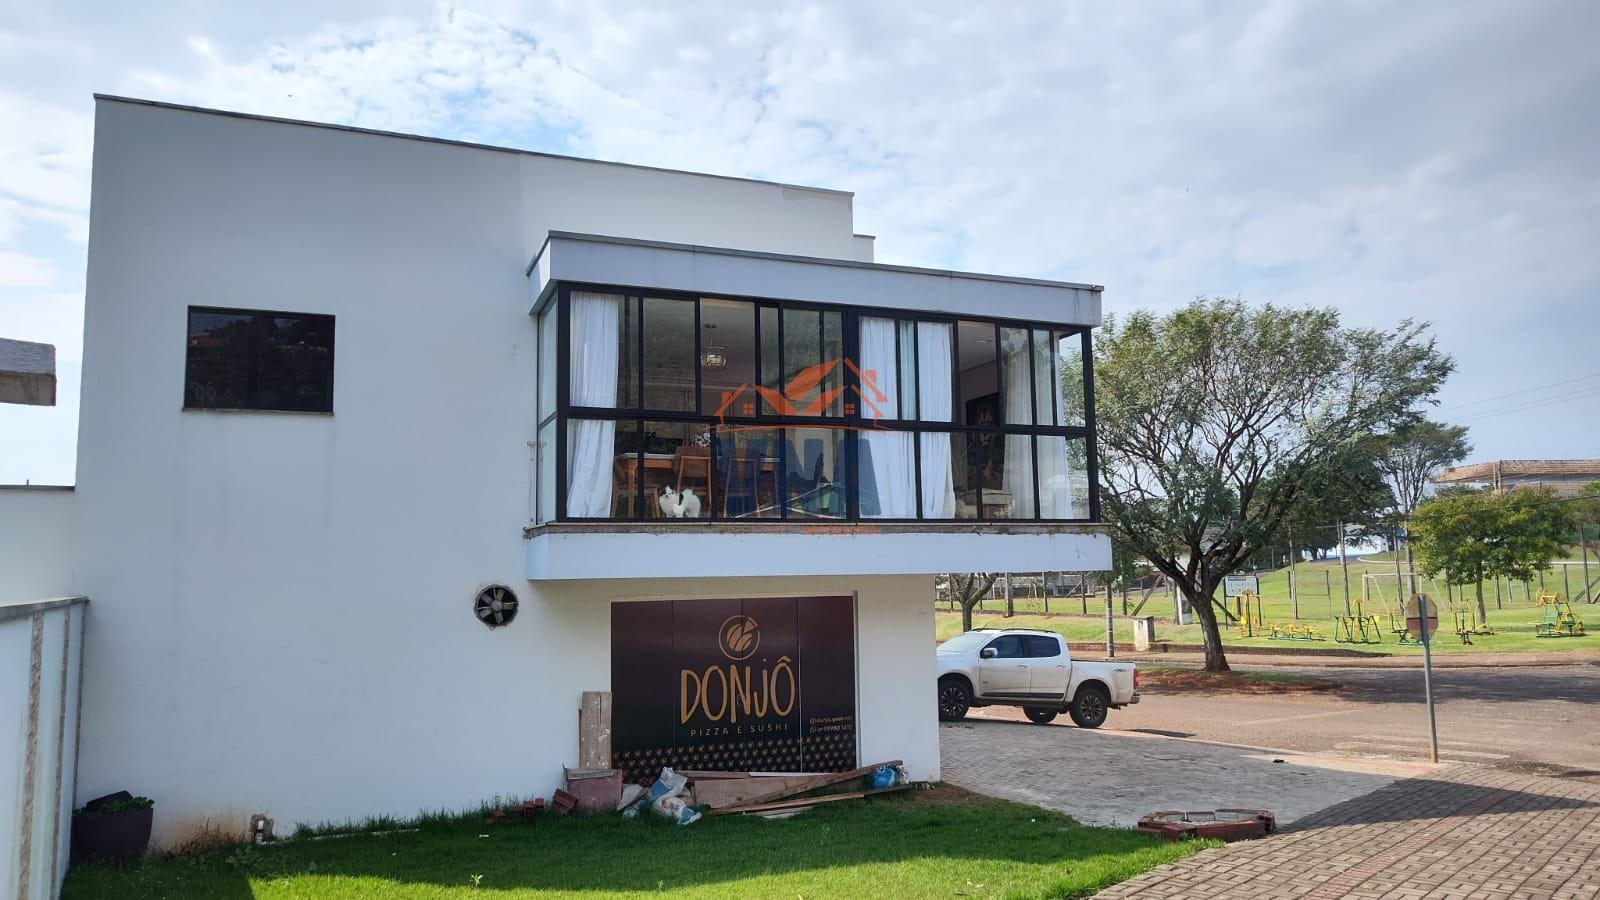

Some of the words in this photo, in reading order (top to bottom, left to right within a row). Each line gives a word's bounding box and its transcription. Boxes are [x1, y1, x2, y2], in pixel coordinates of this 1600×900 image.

[690, 727, 729, 737] PIZZA
[737, 725, 743, 734] E
[750, 722, 788, 734] SUSHI
